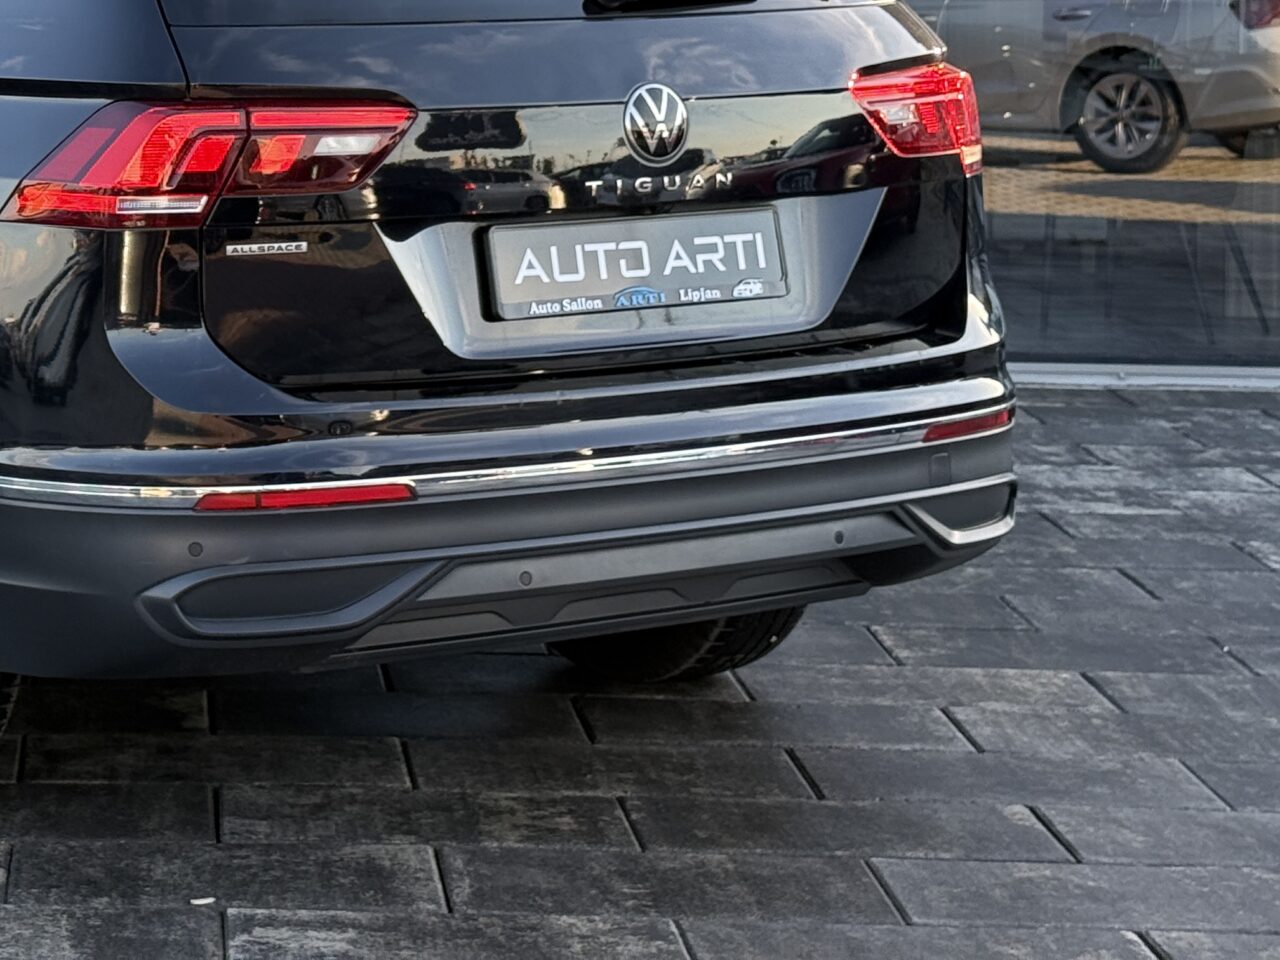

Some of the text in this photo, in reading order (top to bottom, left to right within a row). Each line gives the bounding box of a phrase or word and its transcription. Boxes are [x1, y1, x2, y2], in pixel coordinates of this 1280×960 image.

[585, 172, 733, 197] TIGUAN
[230, 243, 304, 255] ALLSPACE
[515, 232, 766, 285] AUTO ARTI
[529, 300, 560, 315] Auto
[616, 290, 667, 308] ARTI
[679, 288, 721, 303] Lipjan
